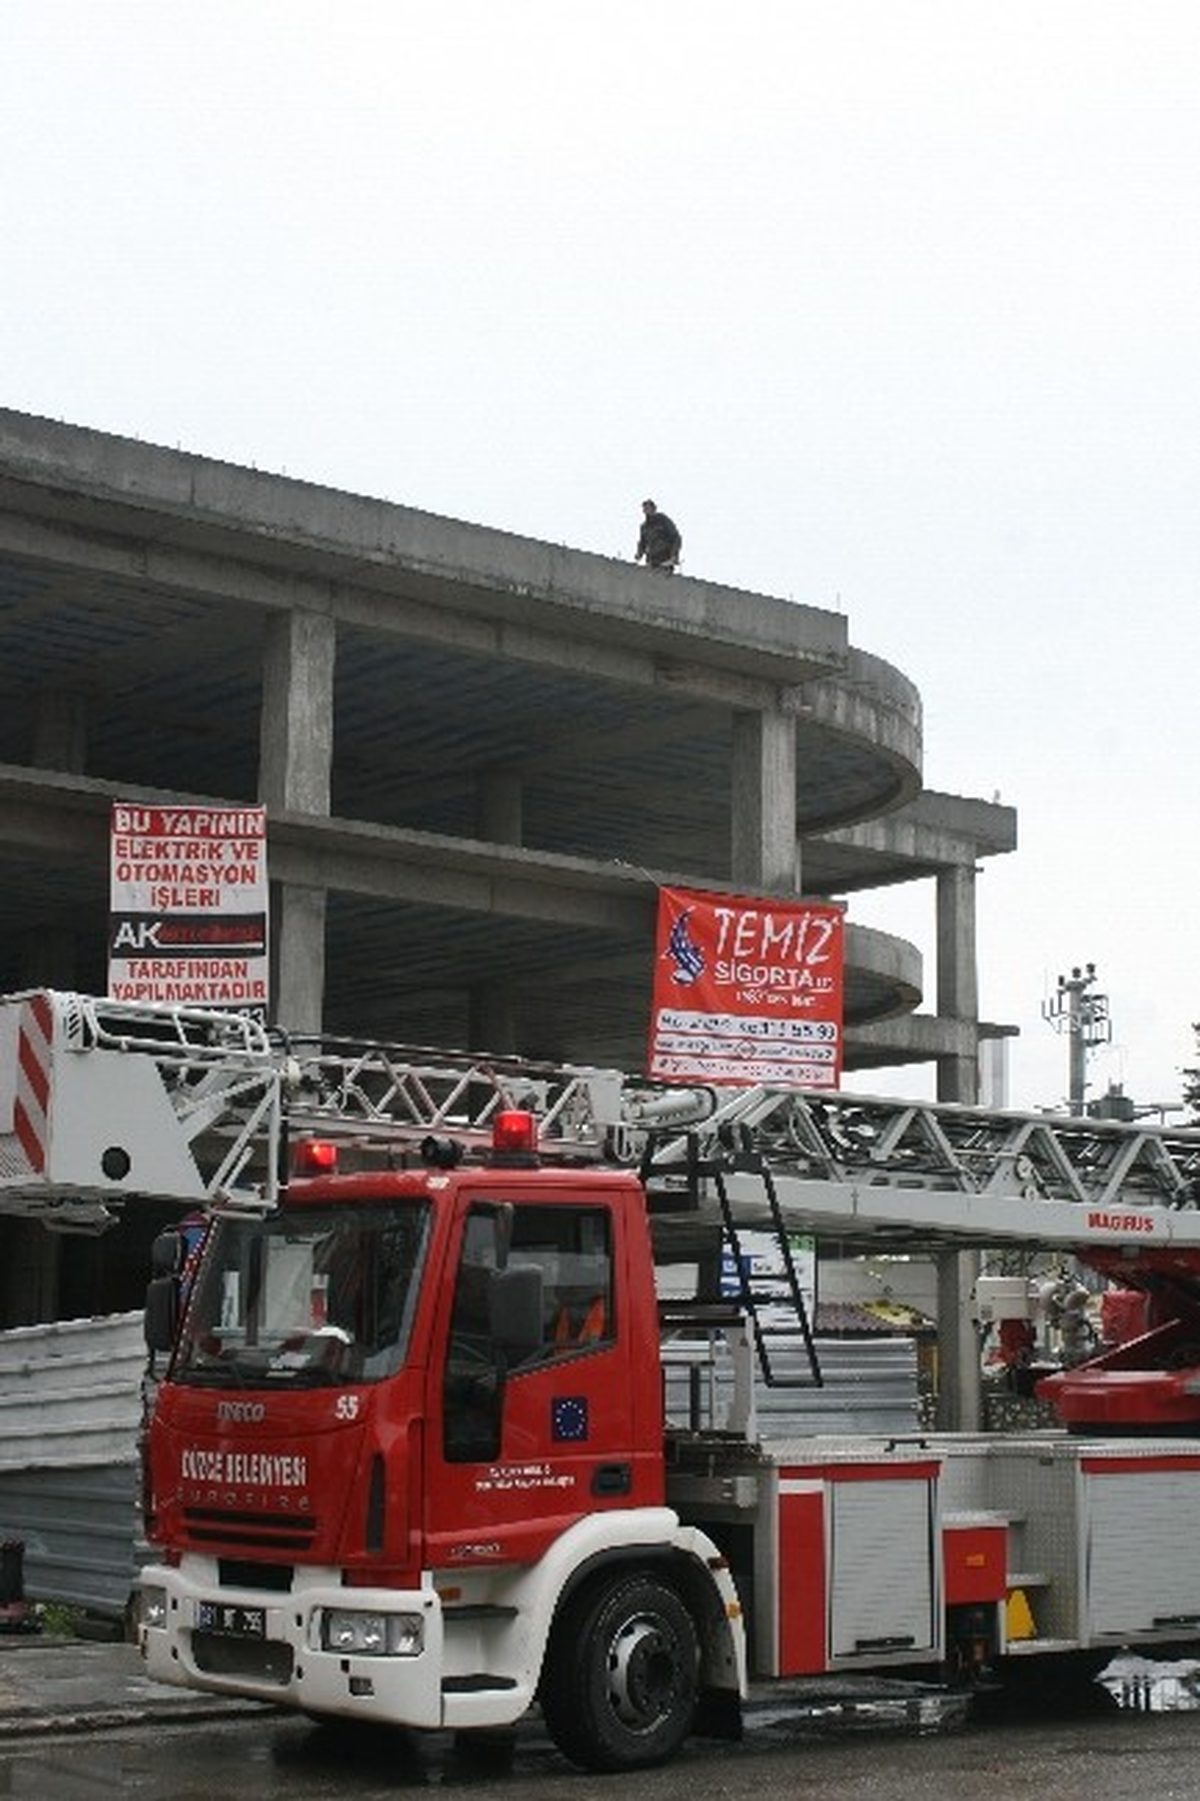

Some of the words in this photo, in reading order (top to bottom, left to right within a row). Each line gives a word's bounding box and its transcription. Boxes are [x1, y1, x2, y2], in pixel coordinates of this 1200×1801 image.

[115, 810, 150, 833] BU
[115, 839, 223, 860] ELEKTRİK
[230, 842, 259, 860] VE
[116, 864, 257, 885] OTOMASYON
[151, 886, 221, 911] İŞLERİ
[113, 921, 163, 949] AK
[714, 907, 840, 965] TEMİZ
[126, 960, 248, 979] TARAFINDAN
[714, 958, 814, 988] SİGORTA
[112, 980, 267, 1001] YAPILMAKTADIR
[225, 1453, 306, 1487] BELEDİYESİ
